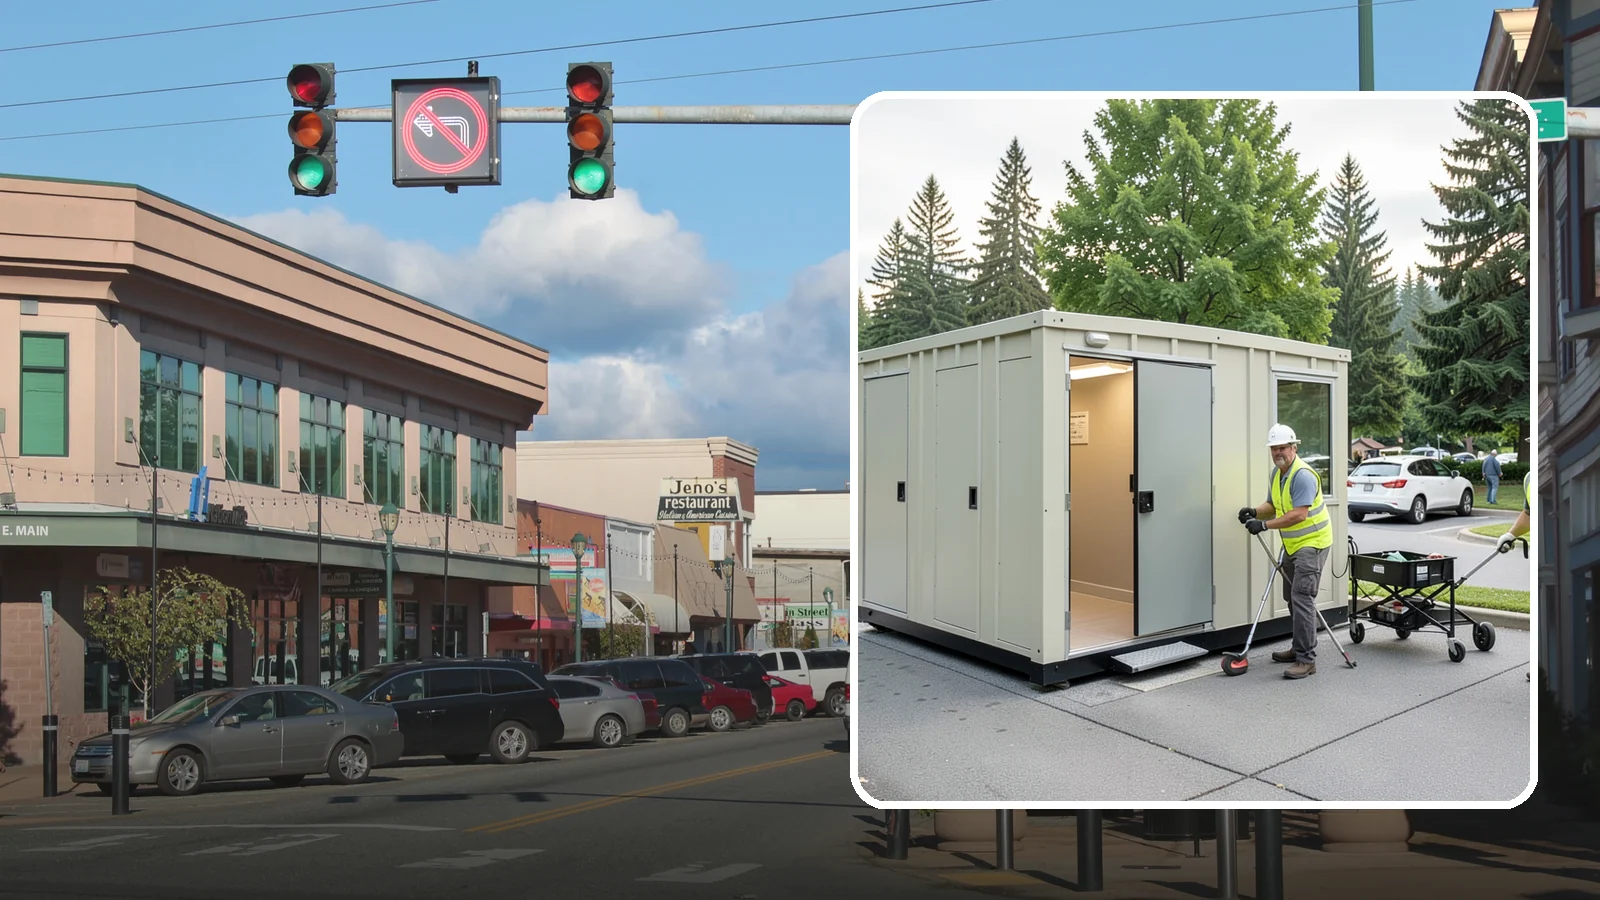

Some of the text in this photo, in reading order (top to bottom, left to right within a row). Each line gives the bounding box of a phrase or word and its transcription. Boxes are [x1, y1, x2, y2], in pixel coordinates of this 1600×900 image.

[669, 480, 727, 494] Jeno's
[665, 496, 731, 509] restaurant
[658, 509, 681, 520] Italian
[686, 509, 715, 519] American
[715, 509, 737, 519] Cuisine
[2, 525, 49, 536] E. MAIN
[797, 607, 828, 617] Street
